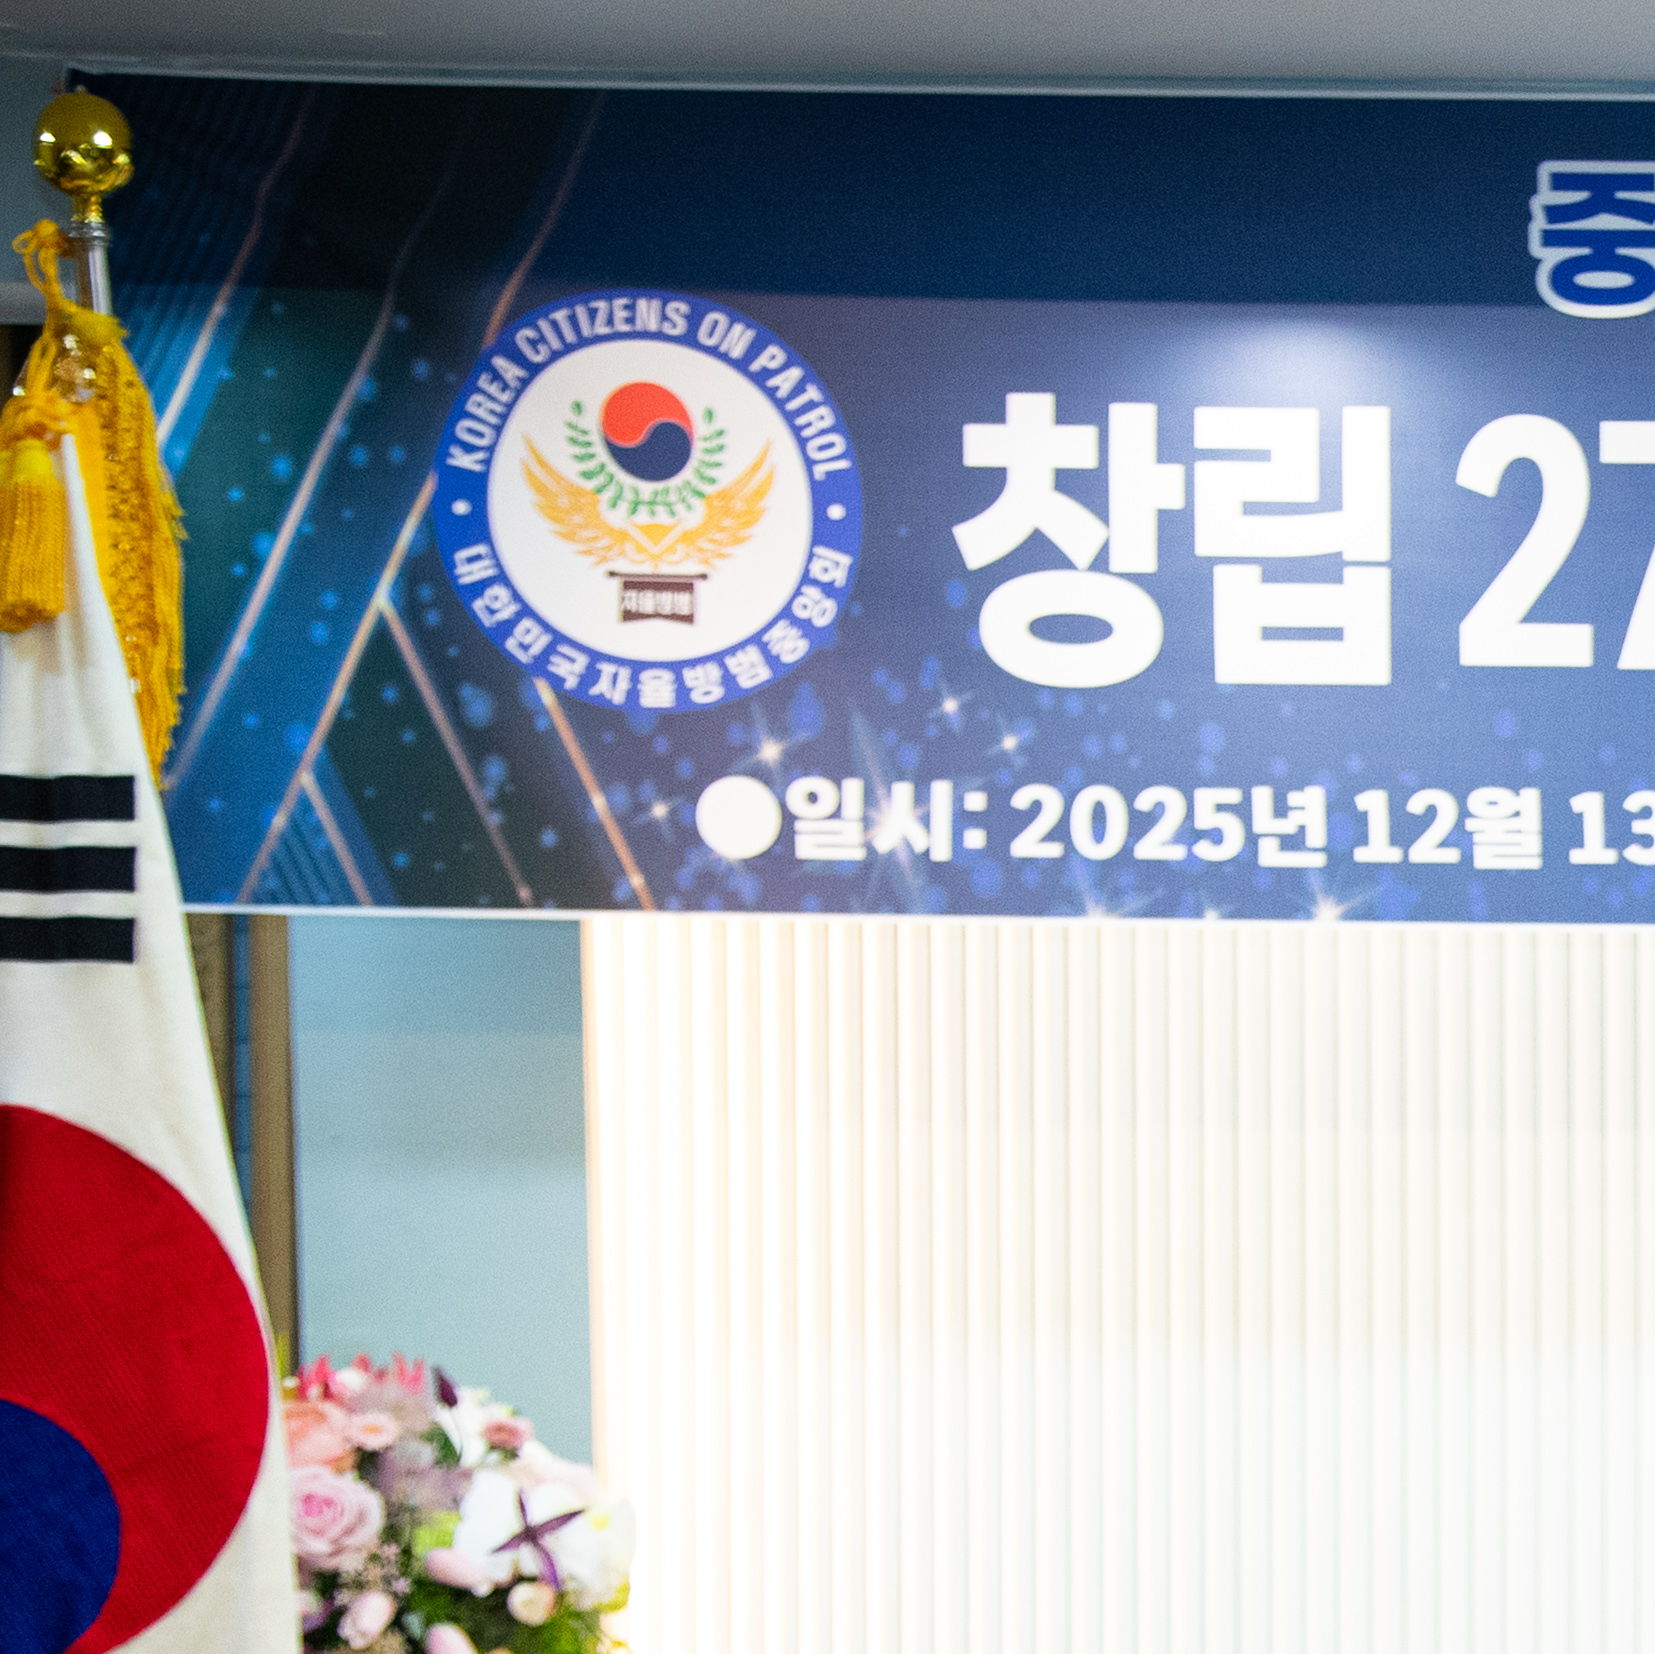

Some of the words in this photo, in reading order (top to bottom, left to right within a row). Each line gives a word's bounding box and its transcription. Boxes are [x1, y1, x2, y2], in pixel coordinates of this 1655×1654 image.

[446, 355, 529, 473] KOREA
[515, 298, 691, 364] CITIZENS
[698, 311, 756, 360] ON
[749, 345, 853, 481] PATROL
[453, 544, 854, 709] 대한민국자율방범중앙회
[952, 391, 1391, 689] 창립
[1010, 783, 1327, 868] 2025년
[1353, 786, 1543, 870] 12월
